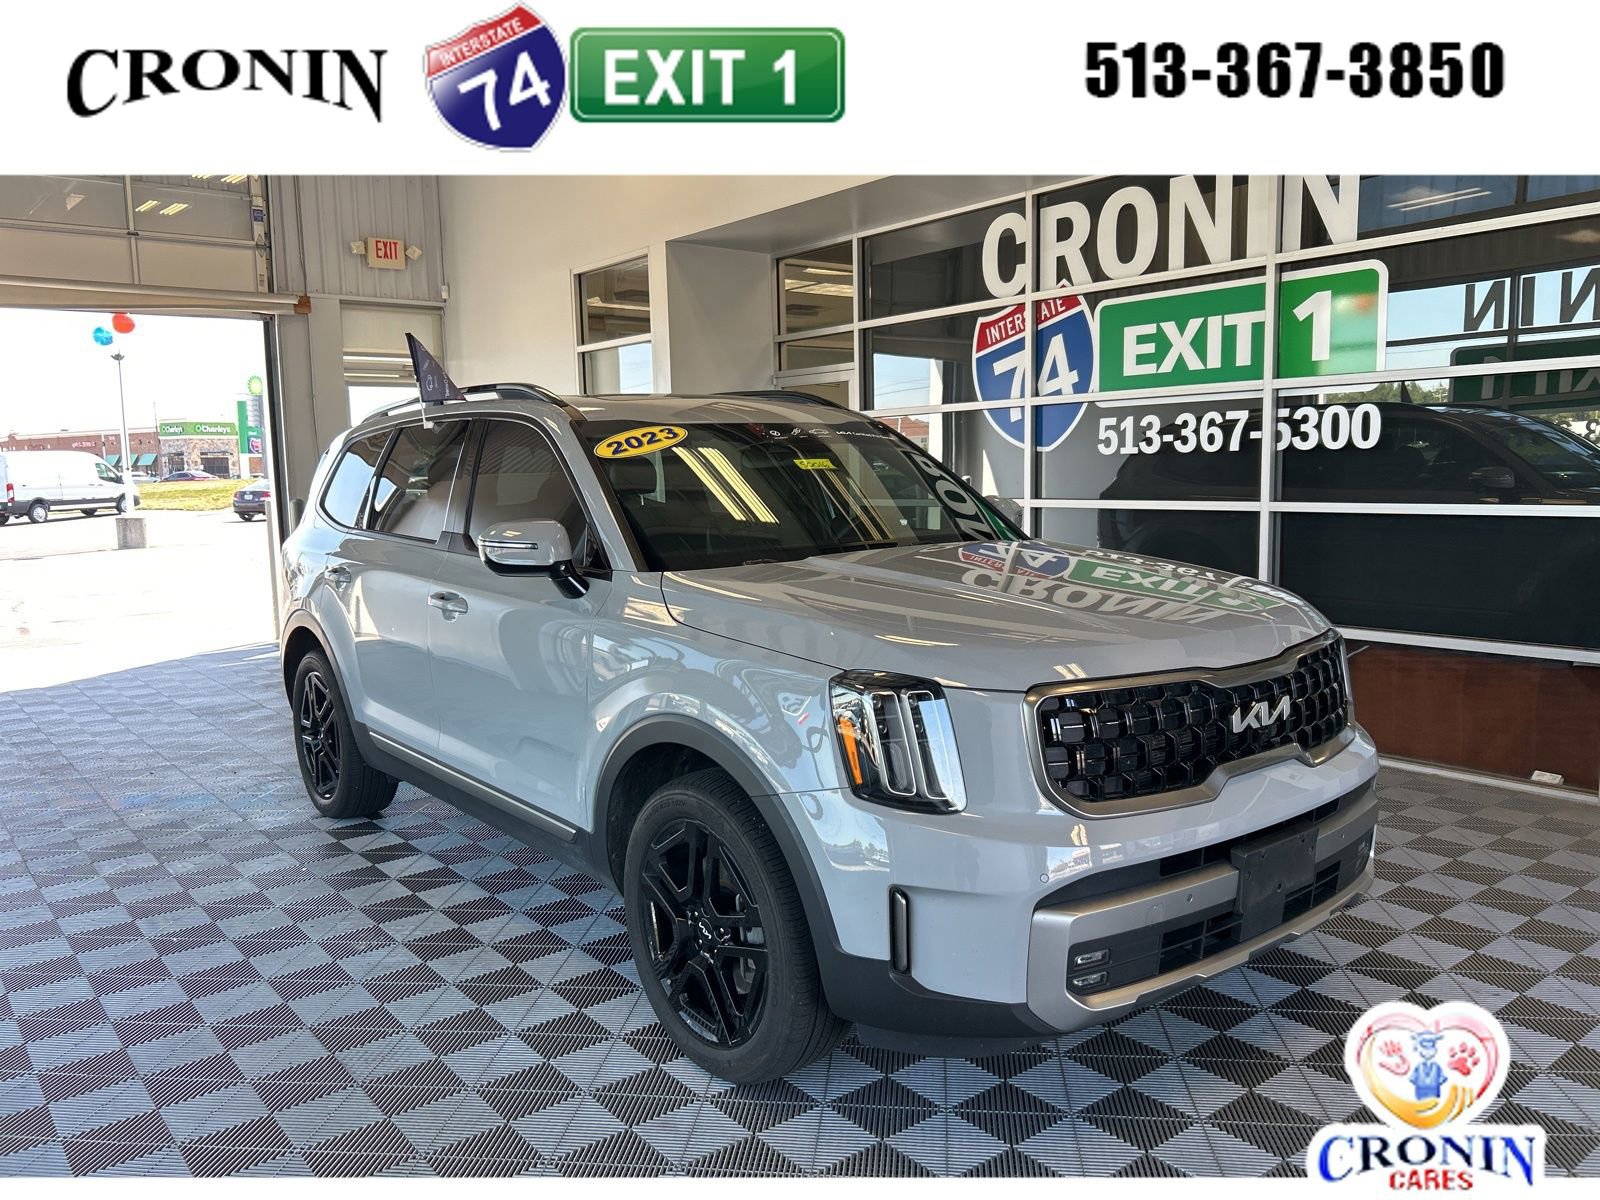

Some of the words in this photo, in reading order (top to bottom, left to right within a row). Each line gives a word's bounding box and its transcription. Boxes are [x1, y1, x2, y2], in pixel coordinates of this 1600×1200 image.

[375, 240, 399, 260] EXIT
[982, 174, 1359, 298] CRONIN
[986, 299, 1066, 345] INTERATE
[1123, 310, 1266, 376] EXIT
[1292, 290, 1332, 361] 1
[993, 333, 1079, 423] 74
[606, 427, 679, 456] 2023
[1097, 403, 1381, 455] 513-367-5300
[1232, 695, 1291, 733] KIA
